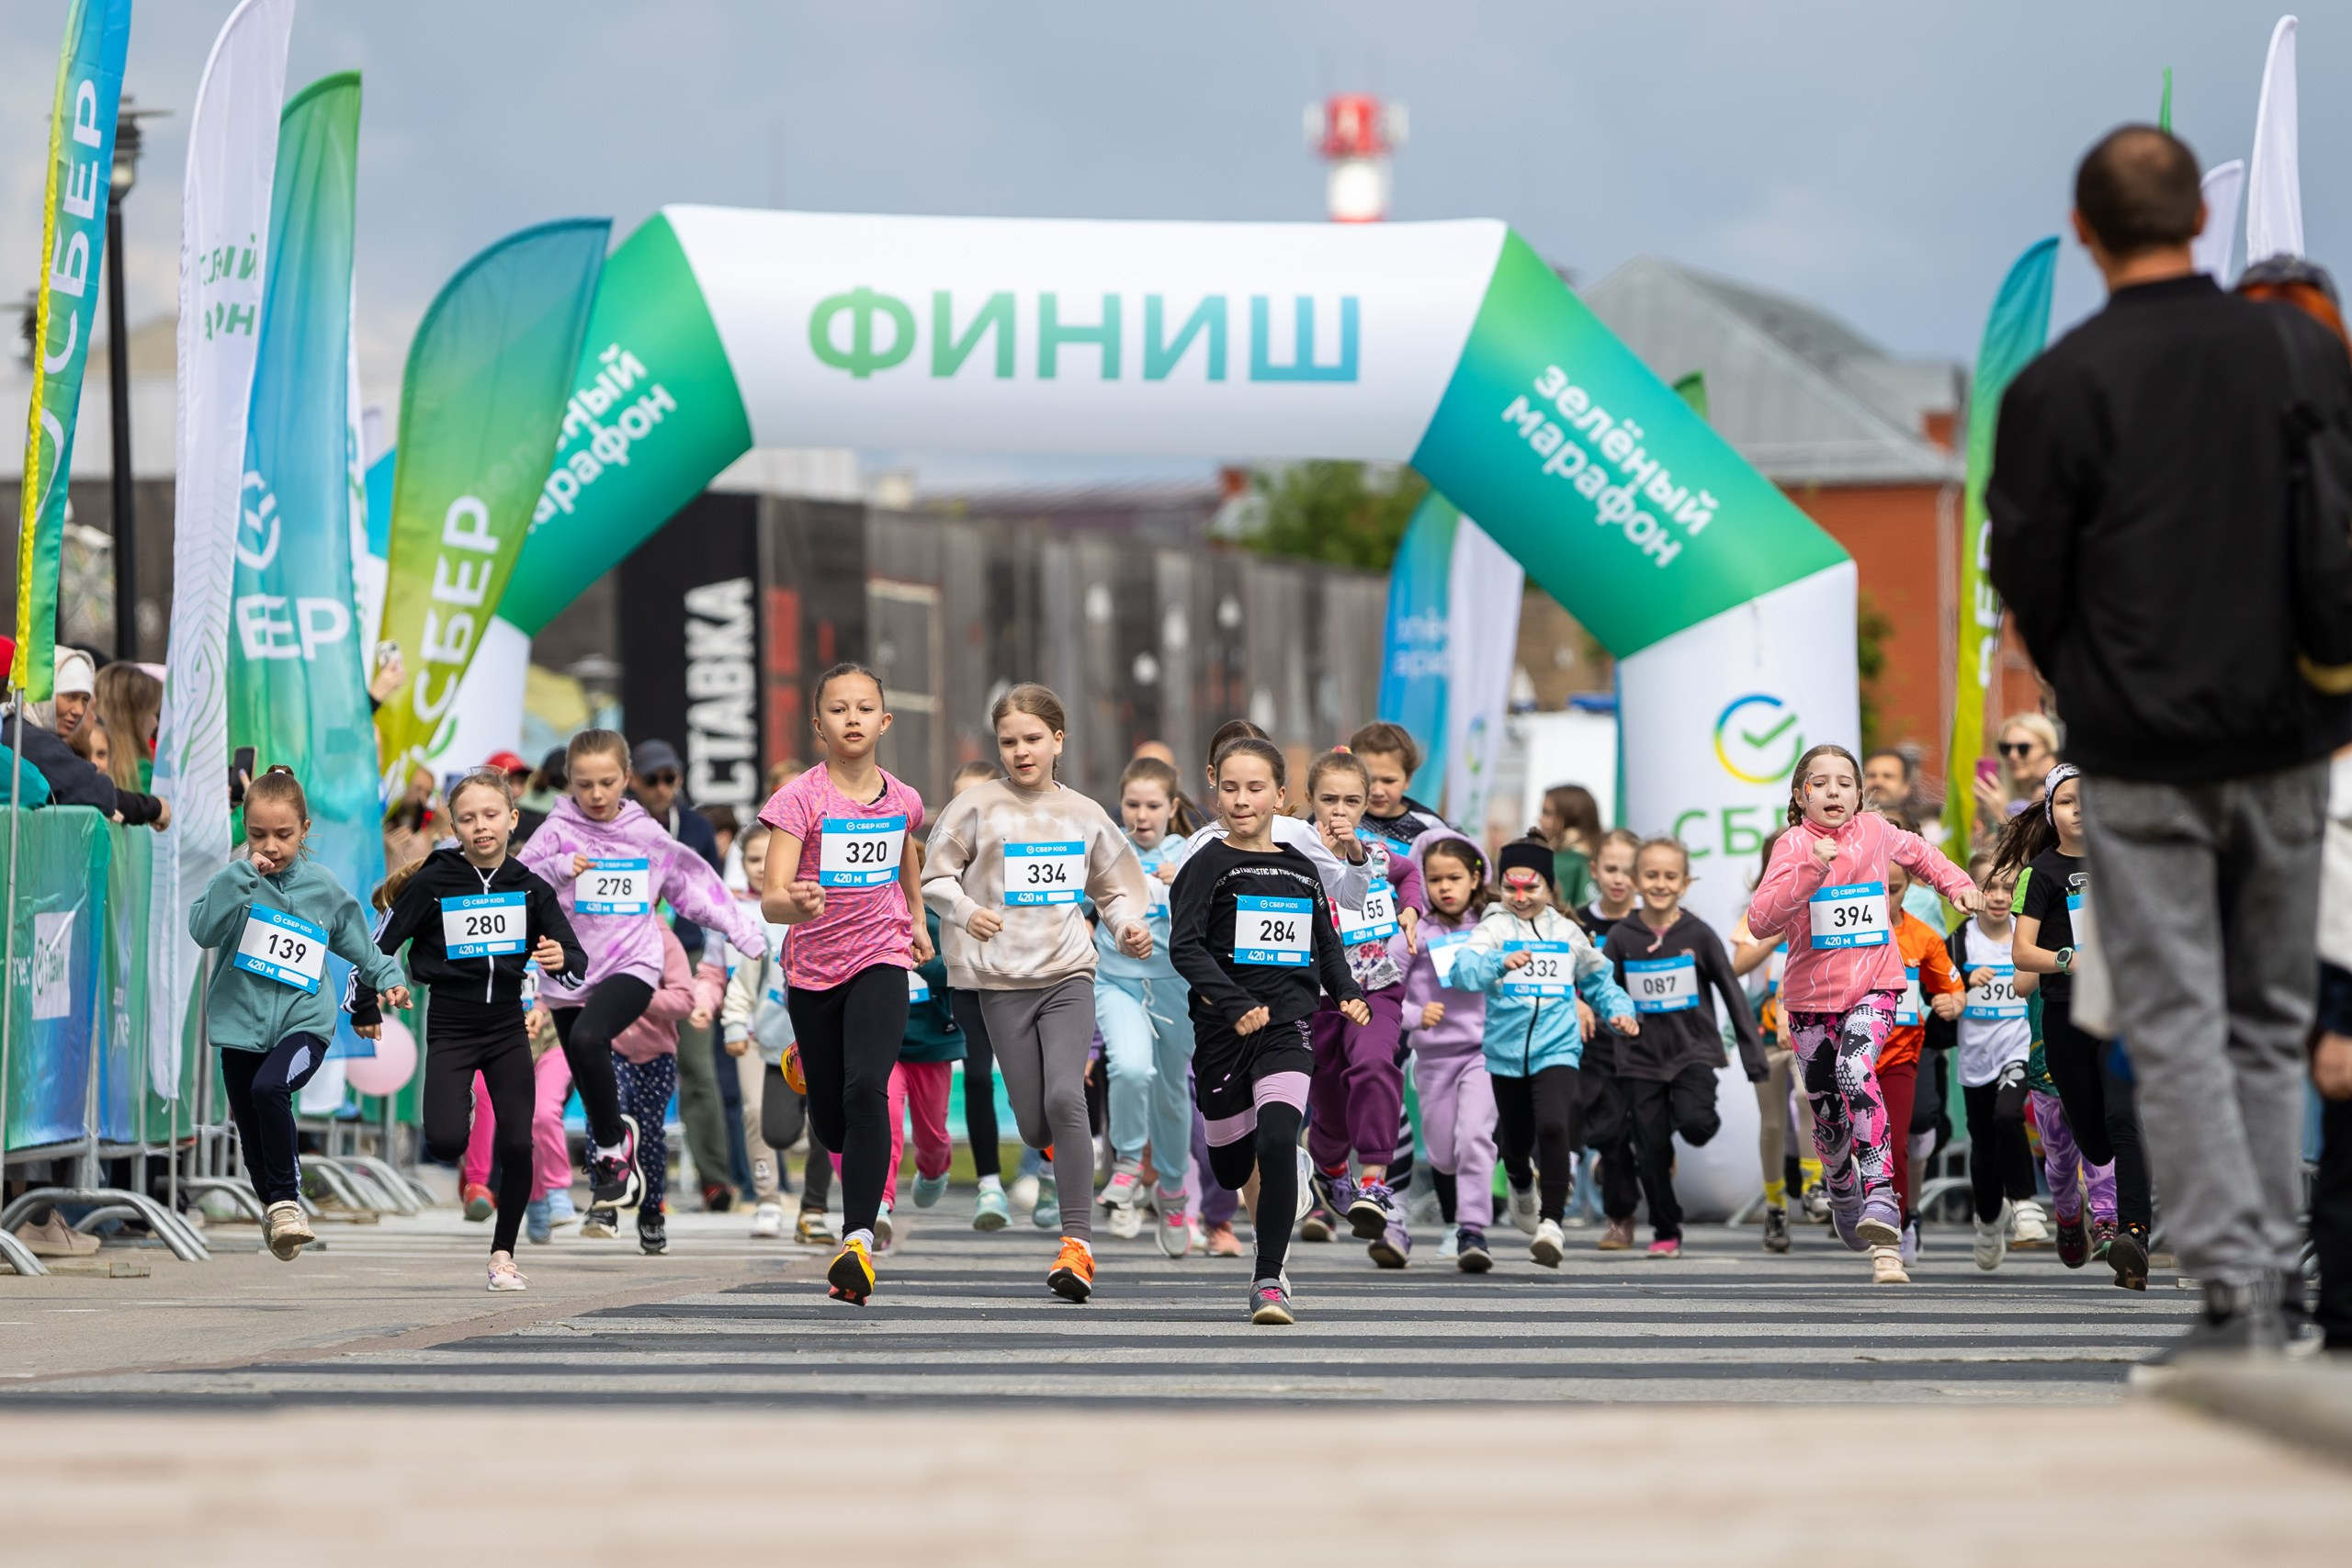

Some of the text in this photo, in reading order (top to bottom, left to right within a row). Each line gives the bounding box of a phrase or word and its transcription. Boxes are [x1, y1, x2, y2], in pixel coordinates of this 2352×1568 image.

[42, 79, 102, 375] СБЕР
[808, 286, 1361, 383] ФИНИШ
[527, 383, 678, 536] арафон
[1533, 364, 1720, 536] зелёный
[1501, 394, 1683, 569] марафон
[413, 494, 500, 724] СБЕР
[684, 576, 758, 826] СТАВКА
[1672, 805, 1789, 860] СБ
[846, 840, 887, 863] 320
[833, 873, 852, 883] 420
[1027, 863, 1067, 884] 334
[596, 878, 632, 896] 278
[1017, 892, 1034, 902] 420
[471, 897, 489, 906] СБЕР
[282, 918, 312, 934] СБЕР KIDS
[465, 914, 505, 936] 280
[1833, 905, 1873, 927] 394
[1260, 919, 1295, 942] 284
[1825, 936, 1841, 946] 420
[268, 934, 307, 964] 139
[458, 944, 474, 955] 420
[1248, 950, 1265, 961] 420
[247, 958, 266, 972] 420
[1524, 959, 1557, 977] 332
[1643, 976, 1677, 995] 087
[1981, 983, 2017, 1000] 390
